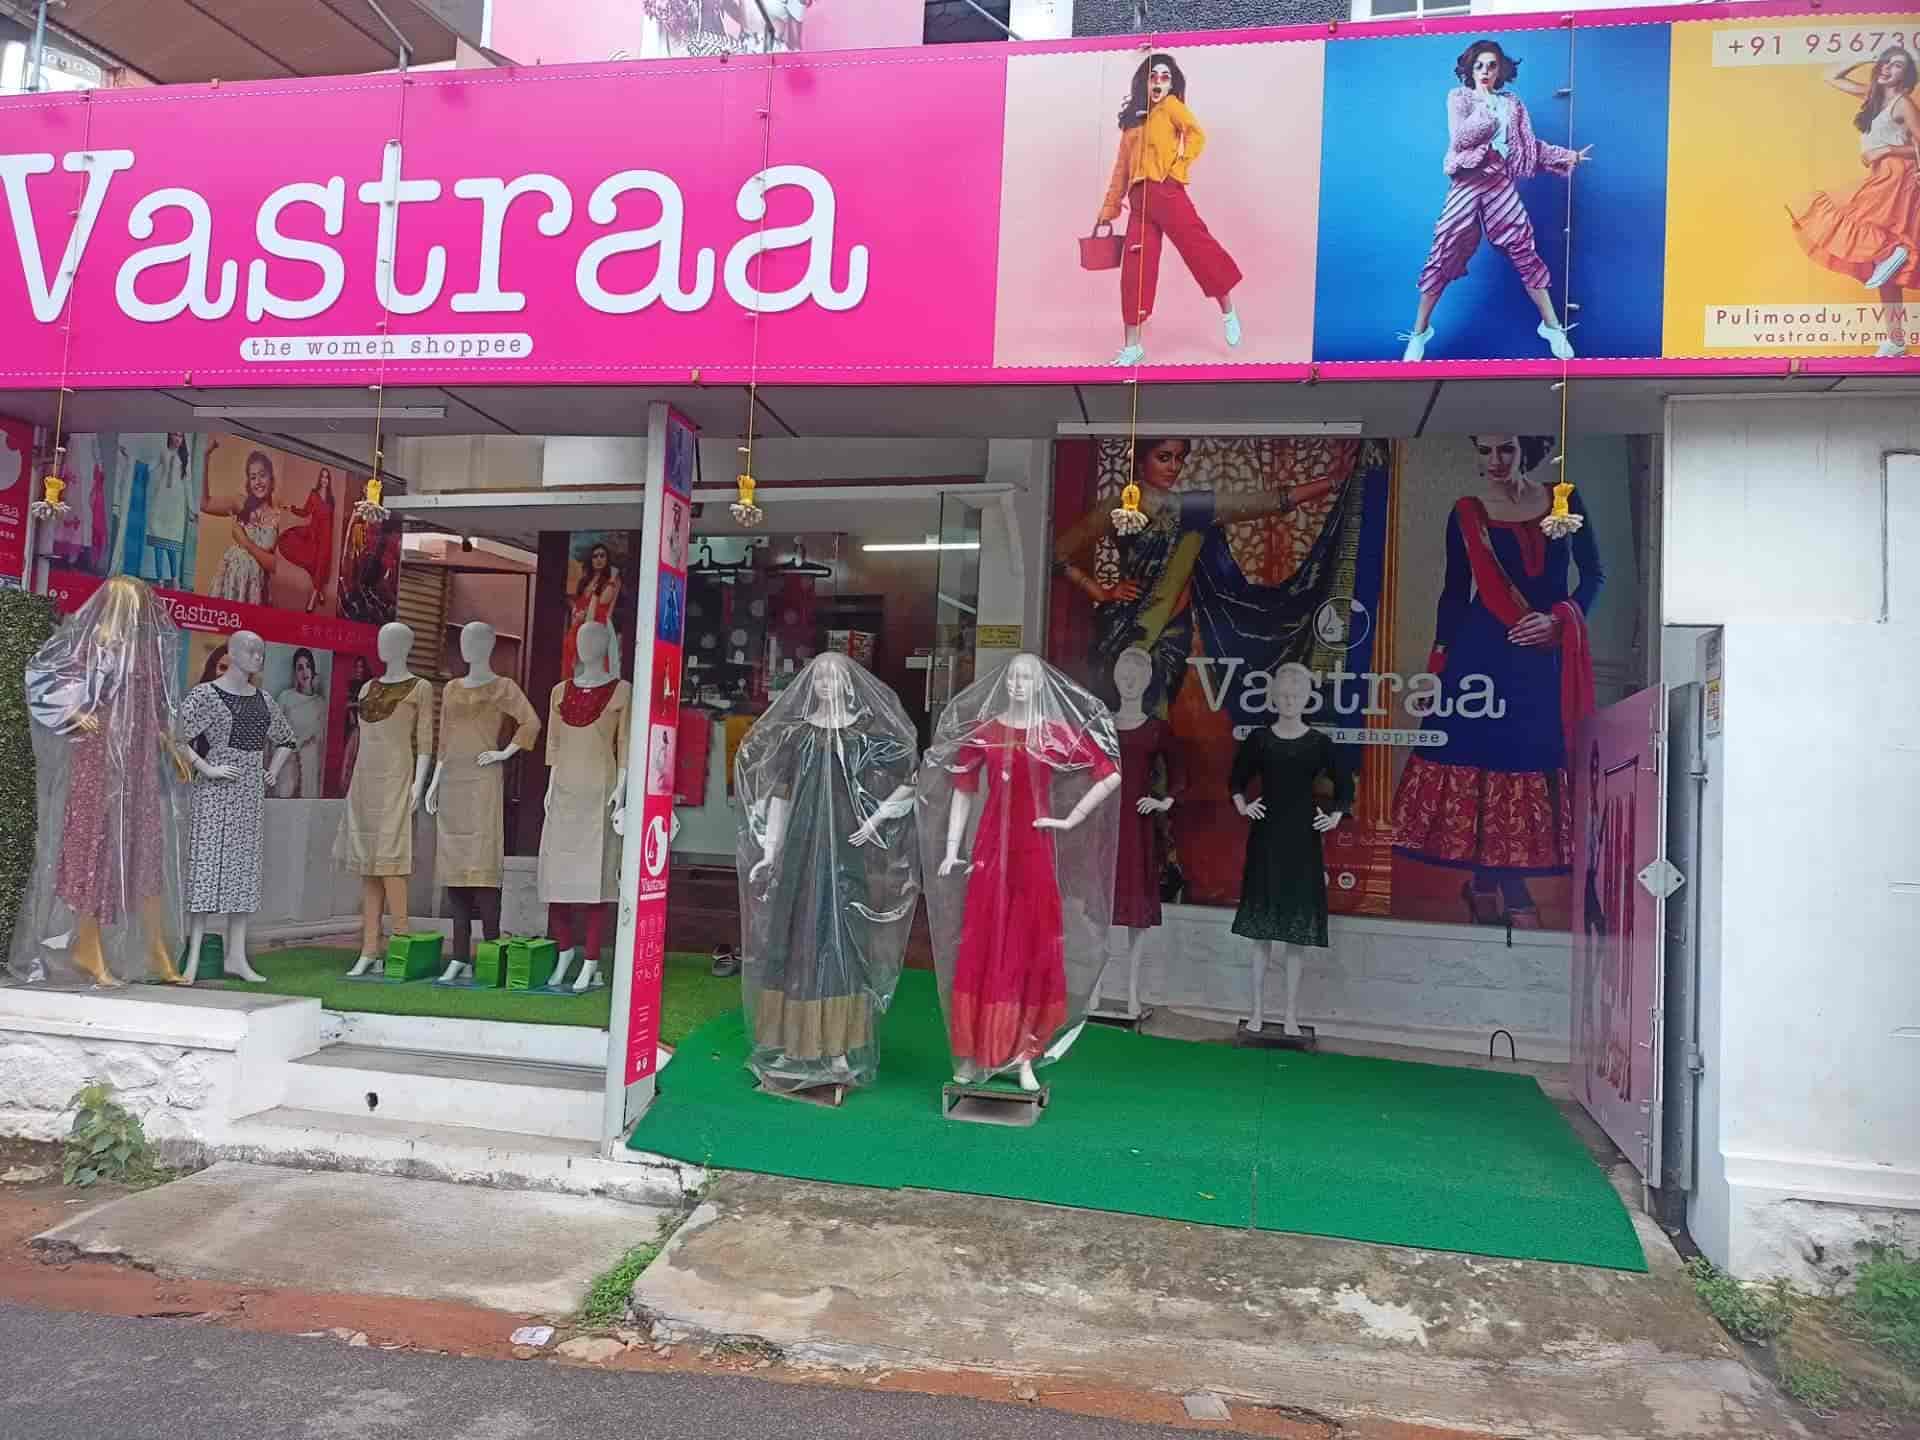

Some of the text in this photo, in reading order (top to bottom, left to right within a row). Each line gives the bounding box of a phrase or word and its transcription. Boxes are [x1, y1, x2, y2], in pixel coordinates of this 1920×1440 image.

[1728, 35, 1783, 56] +91
[0, 139, 868, 323] Vastraa
[250, 336, 522, 357] the women shoppee
[1356, 729, 1440, 744] shoppee
